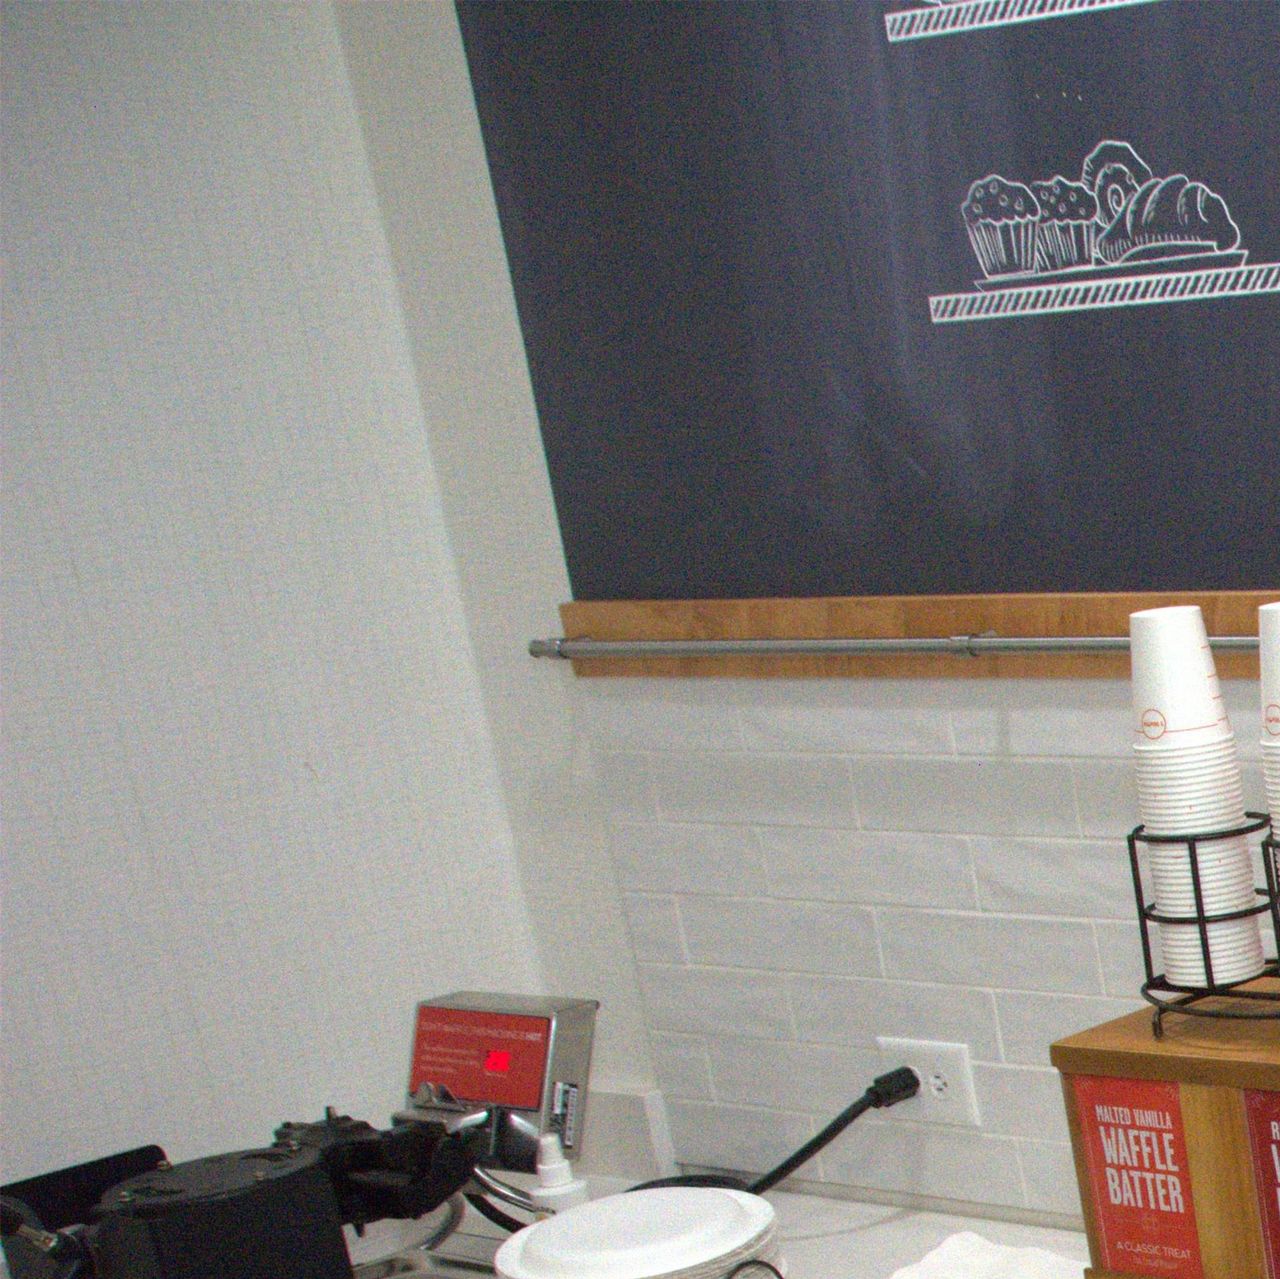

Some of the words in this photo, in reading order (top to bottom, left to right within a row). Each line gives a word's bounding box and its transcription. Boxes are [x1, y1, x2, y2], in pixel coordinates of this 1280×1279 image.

[1095, 1104, 1131, 1125] MALTED
[1132, 1108, 1173, 1129] VANILLA
[1098, 1126, 1179, 1172] WAFFLE
[1105, 1167, 1184, 1213] BATTER
[1162, 1246, 1191, 1258] TREAT
